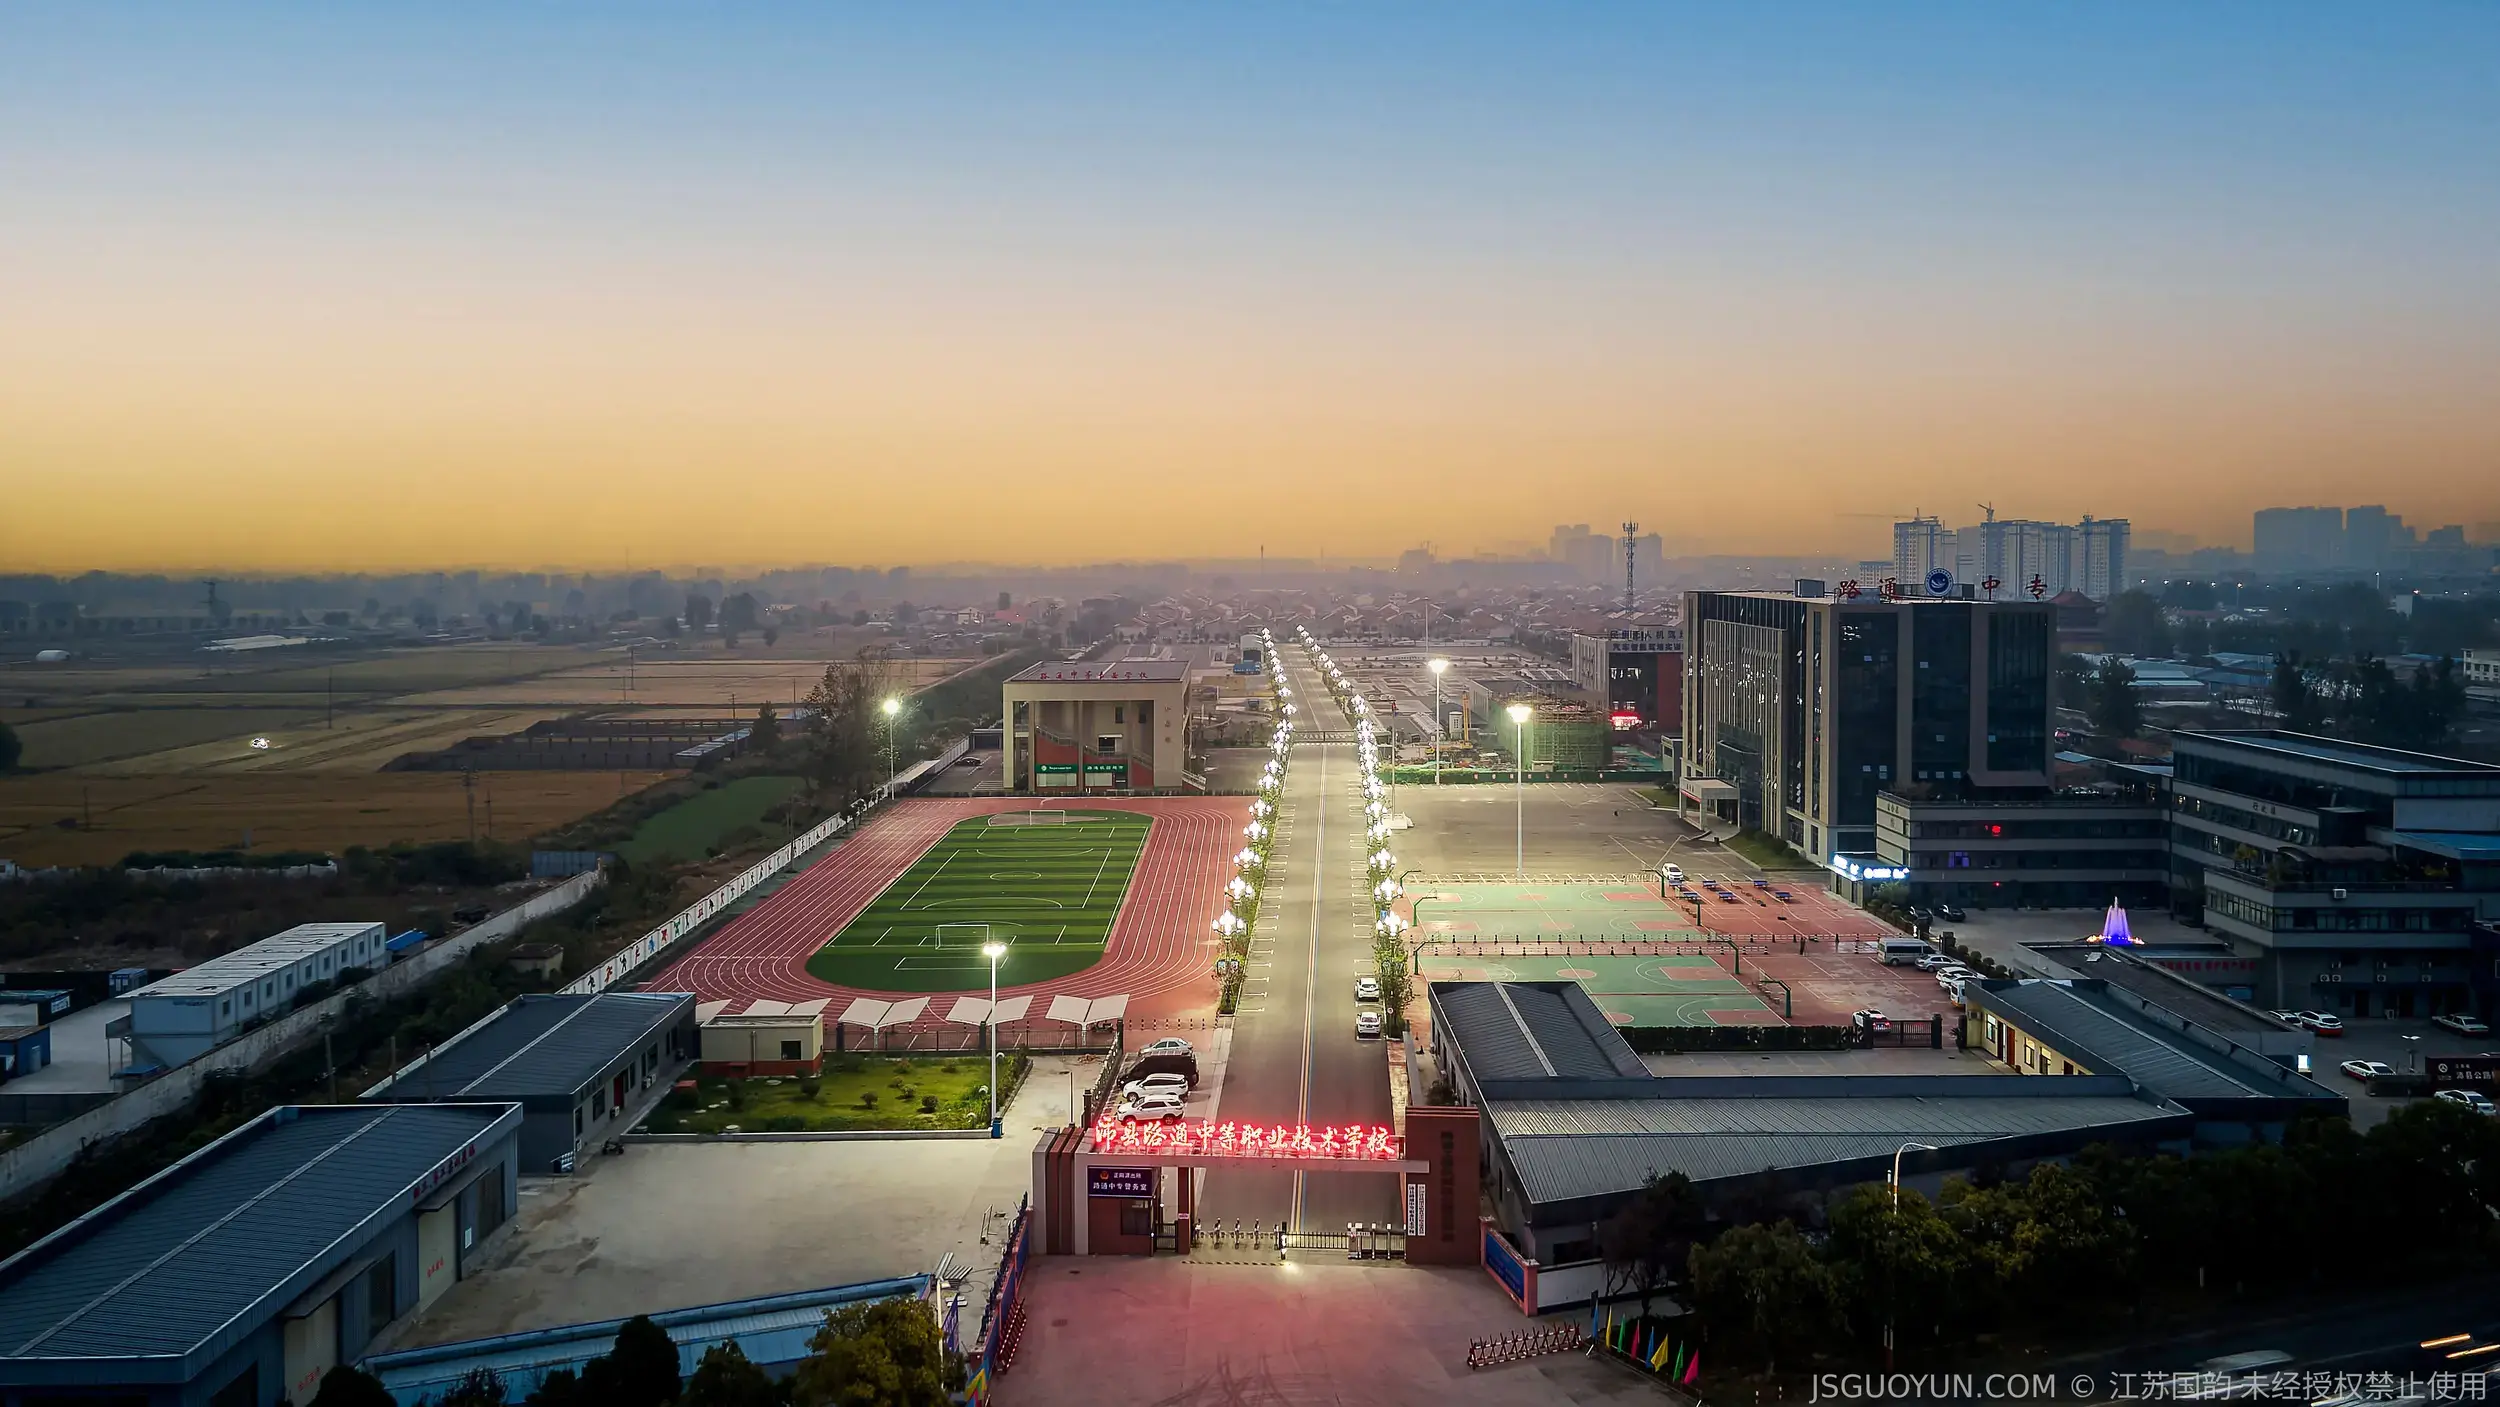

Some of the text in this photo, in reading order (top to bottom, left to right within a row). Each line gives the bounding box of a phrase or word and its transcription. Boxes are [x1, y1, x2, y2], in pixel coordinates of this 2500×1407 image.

[2456, 1071, 2494, 1080] 沛县公路
[1095, 1115, 1395, 1154] 沛县路通中等职业技术学校
